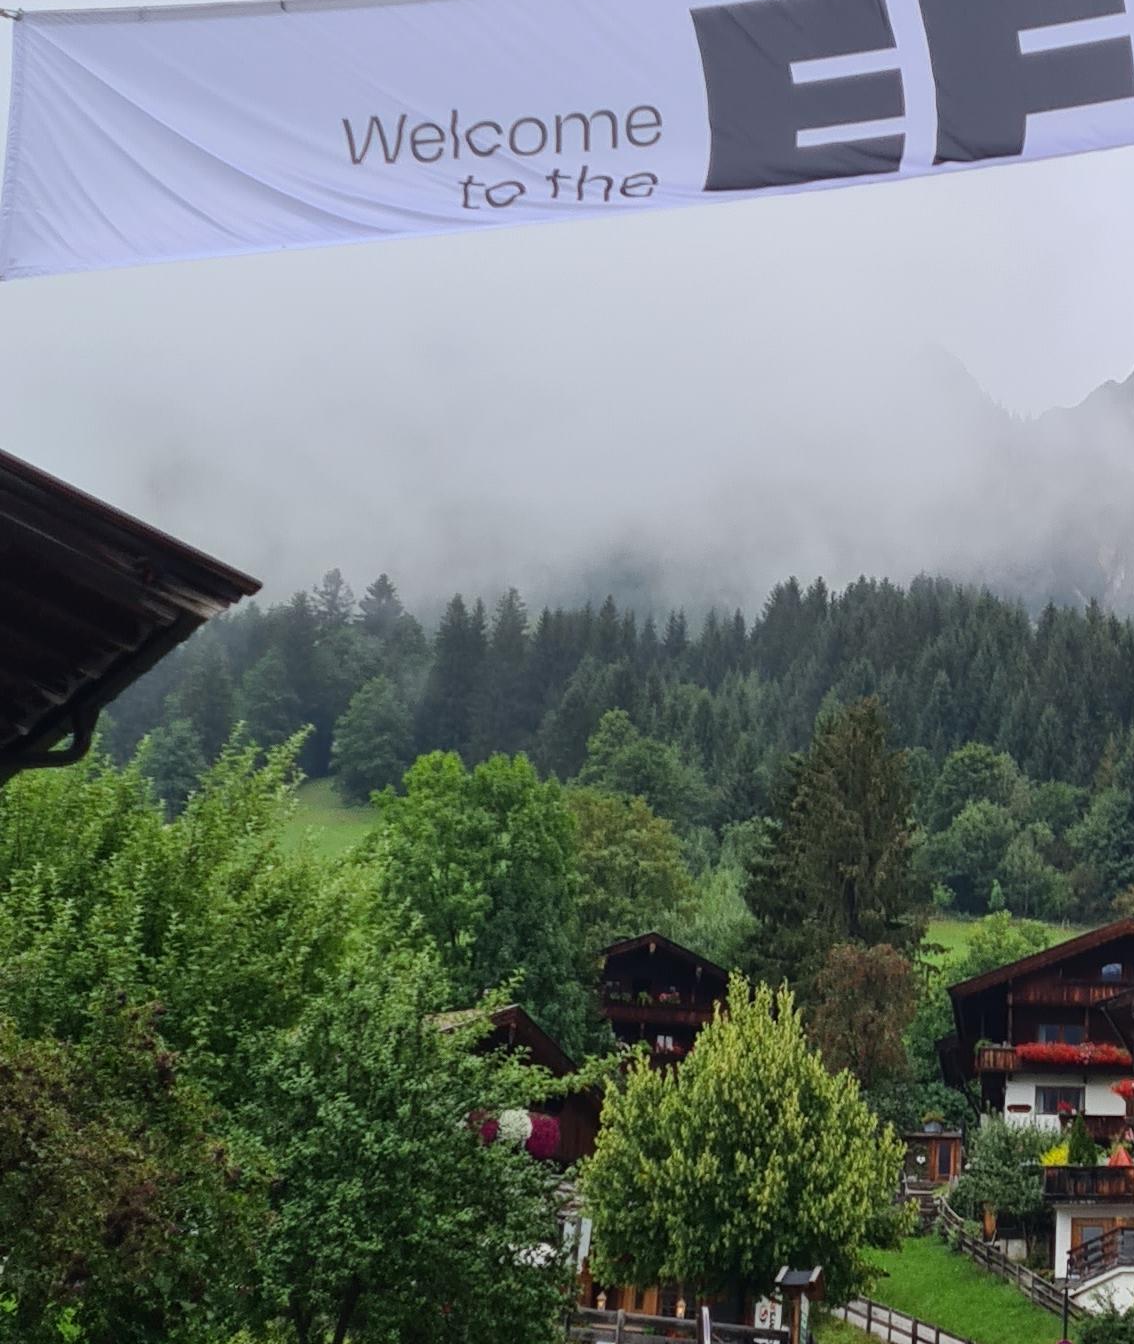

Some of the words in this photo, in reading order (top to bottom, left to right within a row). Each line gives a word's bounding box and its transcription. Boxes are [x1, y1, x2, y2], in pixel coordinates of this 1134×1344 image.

[342, 104, 663, 166] Welcome
[458, 173, 526, 210] to
[545, 165, 660, 202] the
